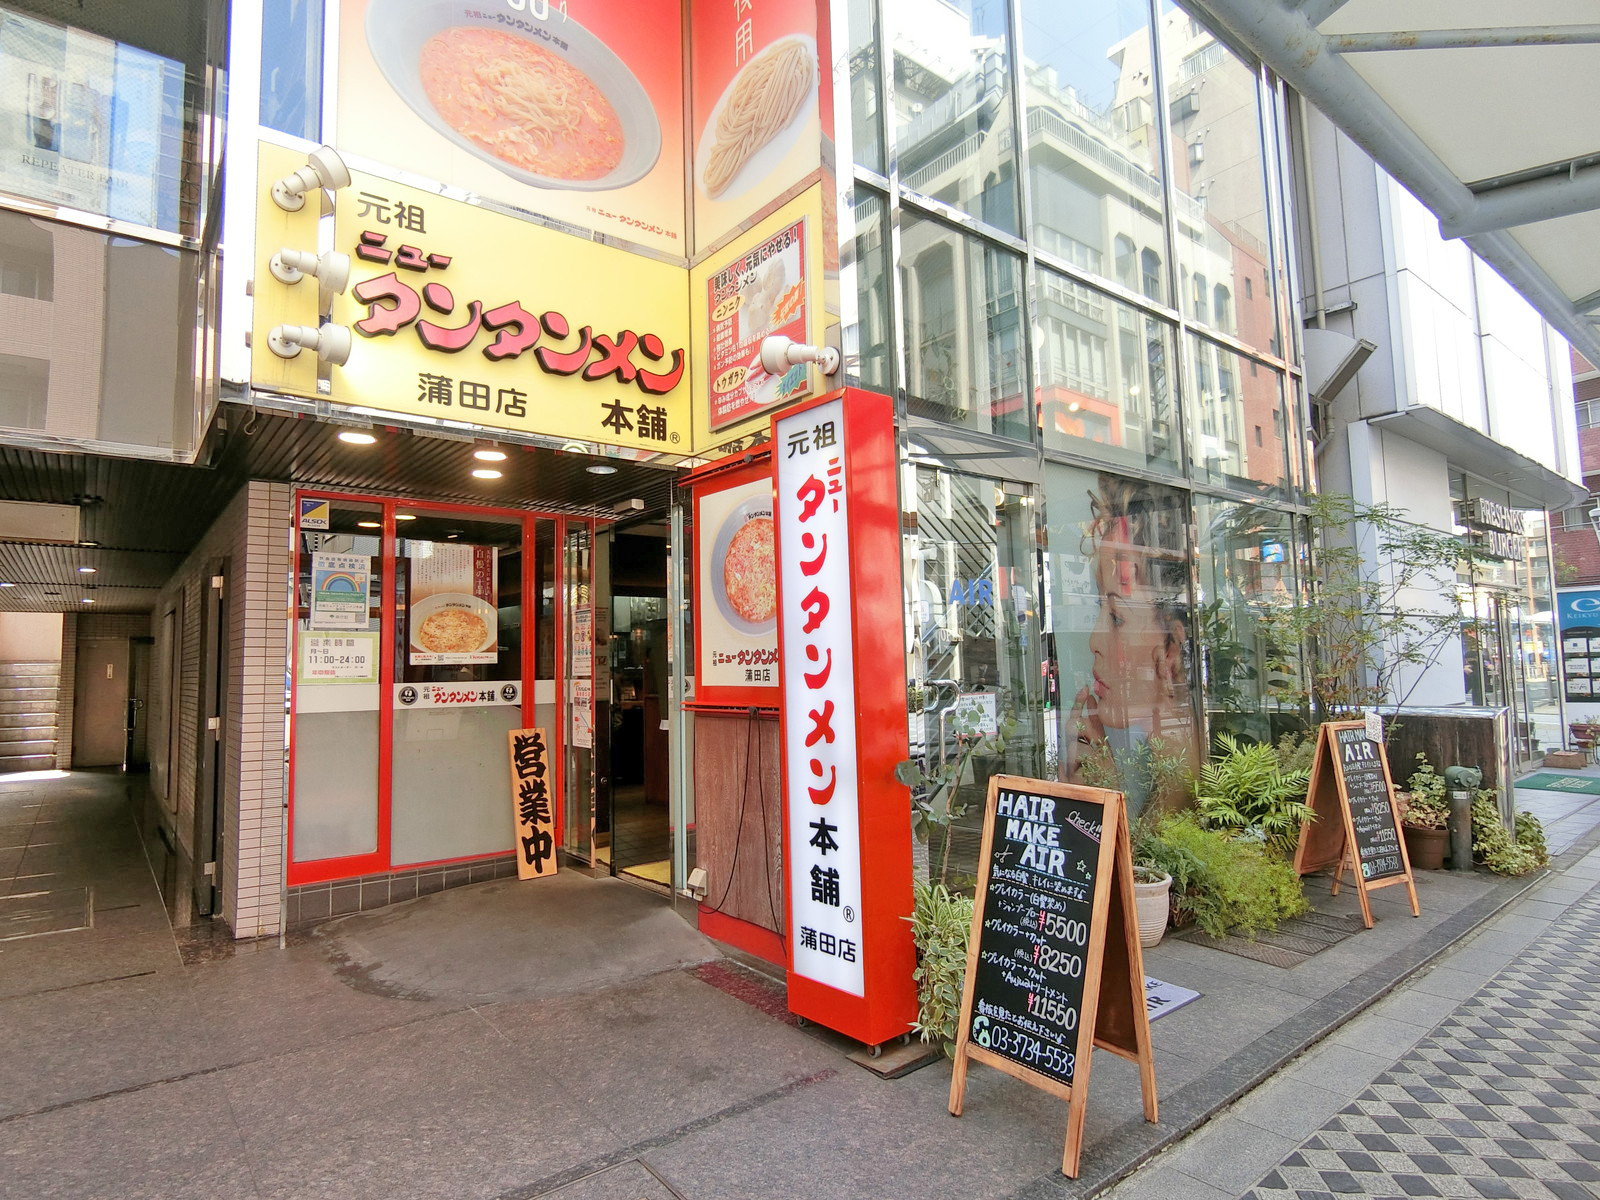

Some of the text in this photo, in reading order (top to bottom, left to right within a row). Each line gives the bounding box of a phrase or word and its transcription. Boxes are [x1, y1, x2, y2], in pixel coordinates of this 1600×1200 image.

[22, 154, 94, 181] REPEATER
[357, 191, 426, 234] 元祖
[355, 230, 452, 273] ニュー
[716, 296, 741, 319] ニンニク
[352, 272, 684, 396] タンタンメン
[418, 373, 527, 418] 蒲田店
[716, 369, 746, 392] トウガラシ
[601, 399, 667, 442] 本舗
[787, 421, 837, 459] 元祖
[827, 457, 842, 513] ニュー
[1480, 498, 1525, 535] FRESHNESS
[1488, 530, 1522, 561] BURGER
[949, 578, 993, 606] AIR
[310, 638, 355, 647] 営業時間
[797, 474, 836, 806] タンタンメン
[309, 655, 366, 664] 11:00-24:00
[745, 668, 771, 681] 蒲田店
[434, 691, 478, 703] タンタンメン
[479, 690, 496, 702] 本舗
[1345, 741, 1374, 762] AIR
[513, 732, 553, 874] 営業中
[998, 792, 1056, 823] HAIR
[1006, 818, 1060, 848] MAKE
[1068, 810, 1102, 838] Check!!
[809, 817, 840, 908] 本舗
[1019, 844, 1065, 877] AIR
[800, 926, 856, 963] 蒲田店
[1039, 910, 1087, 946] ¥5500
[1033, 944, 1082, 978] ¥8250
[1028, 992, 1077, 1030] ¥11550
[992, 1025, 1075, 1077] 03-3734-5533
